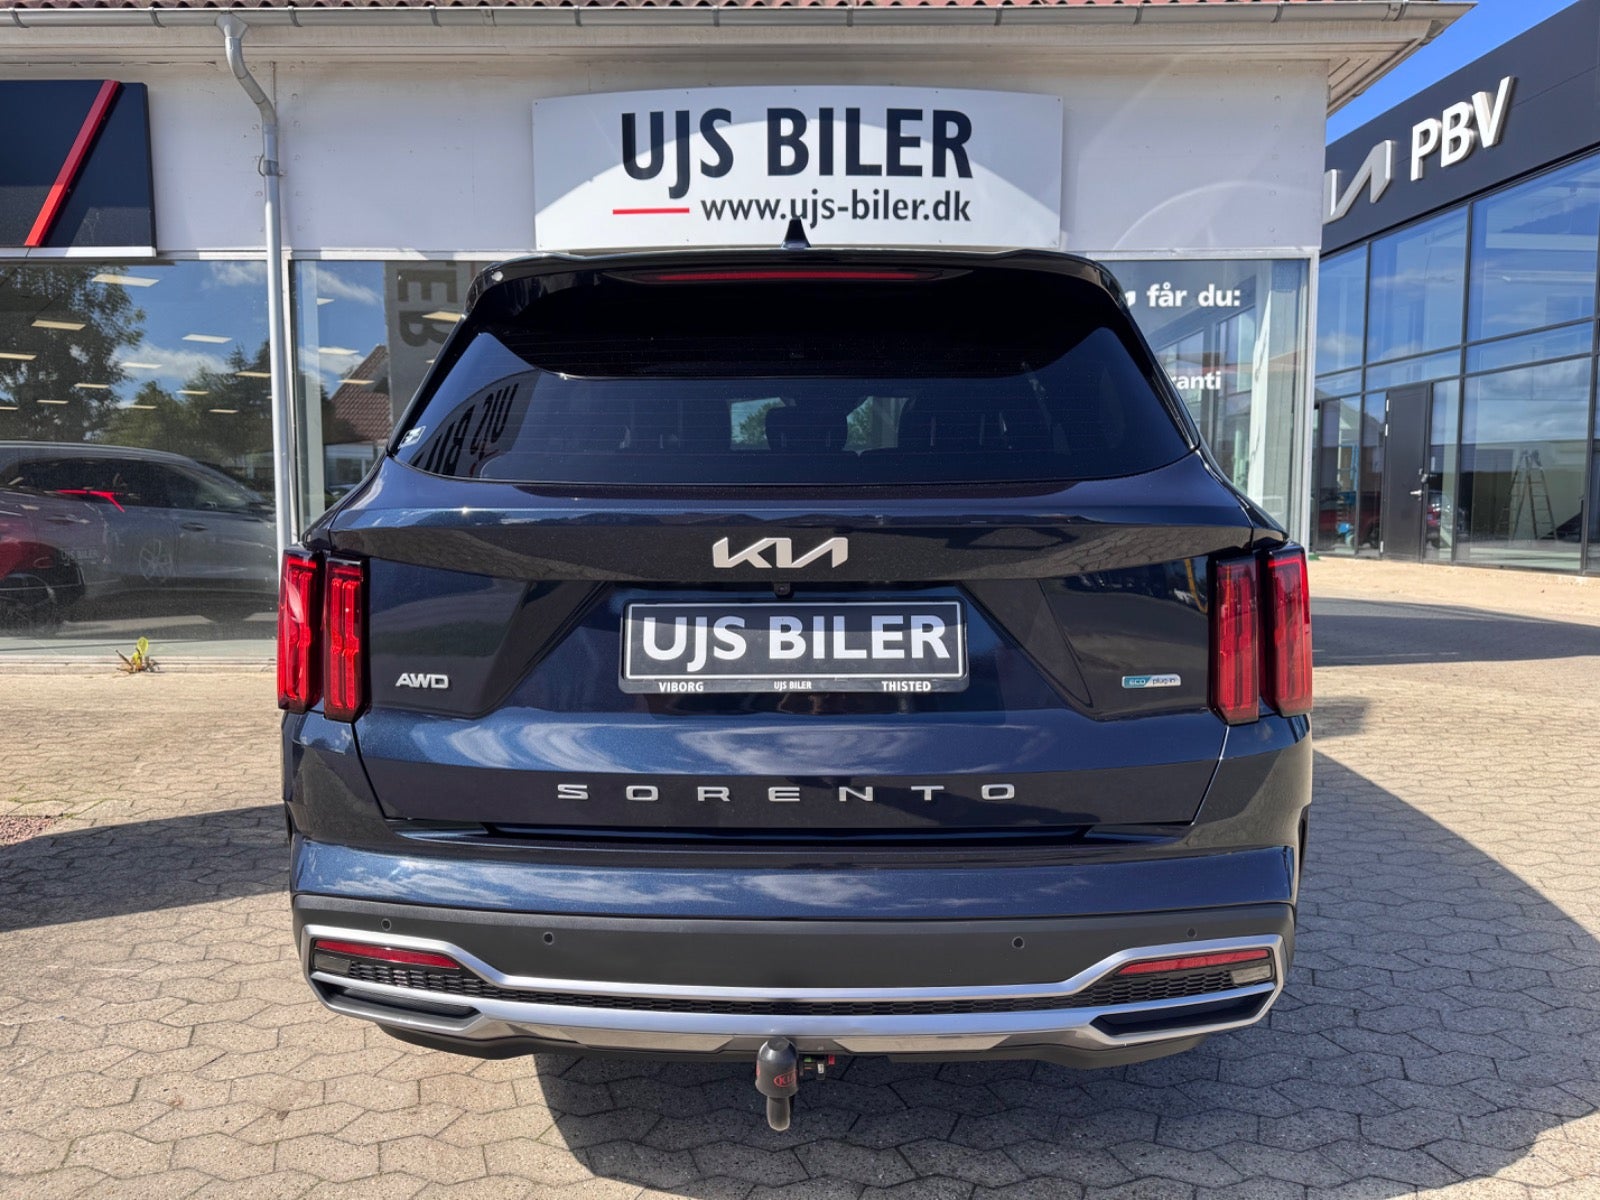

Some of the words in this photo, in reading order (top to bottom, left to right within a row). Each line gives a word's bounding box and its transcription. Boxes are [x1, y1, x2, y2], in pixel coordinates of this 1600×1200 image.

[1410, 76, 1514, 182] PBV
[621, 108, 734, 200] UJS
[767, 107, 973, 179] BILER
[700, 188, 971, 229] www.ujs-biler.dk
[1147, 282, 1188, 308] får
[1198, 284, 1241, 308] du:
[712, 536, 849, 569] KIA
[642, 616, 747, 672] UJS
[769, 615, 950, 660] BILER
[395, 673, 449, 689] AWD
[659, 681, 705, 692] VIBORG
[774, 681, 788, 691] UJS
[789, 681, 812, 690] BILER
[882, 680, 932, 692] THISTED
[557, 783, 1016, 803] SORENTO
